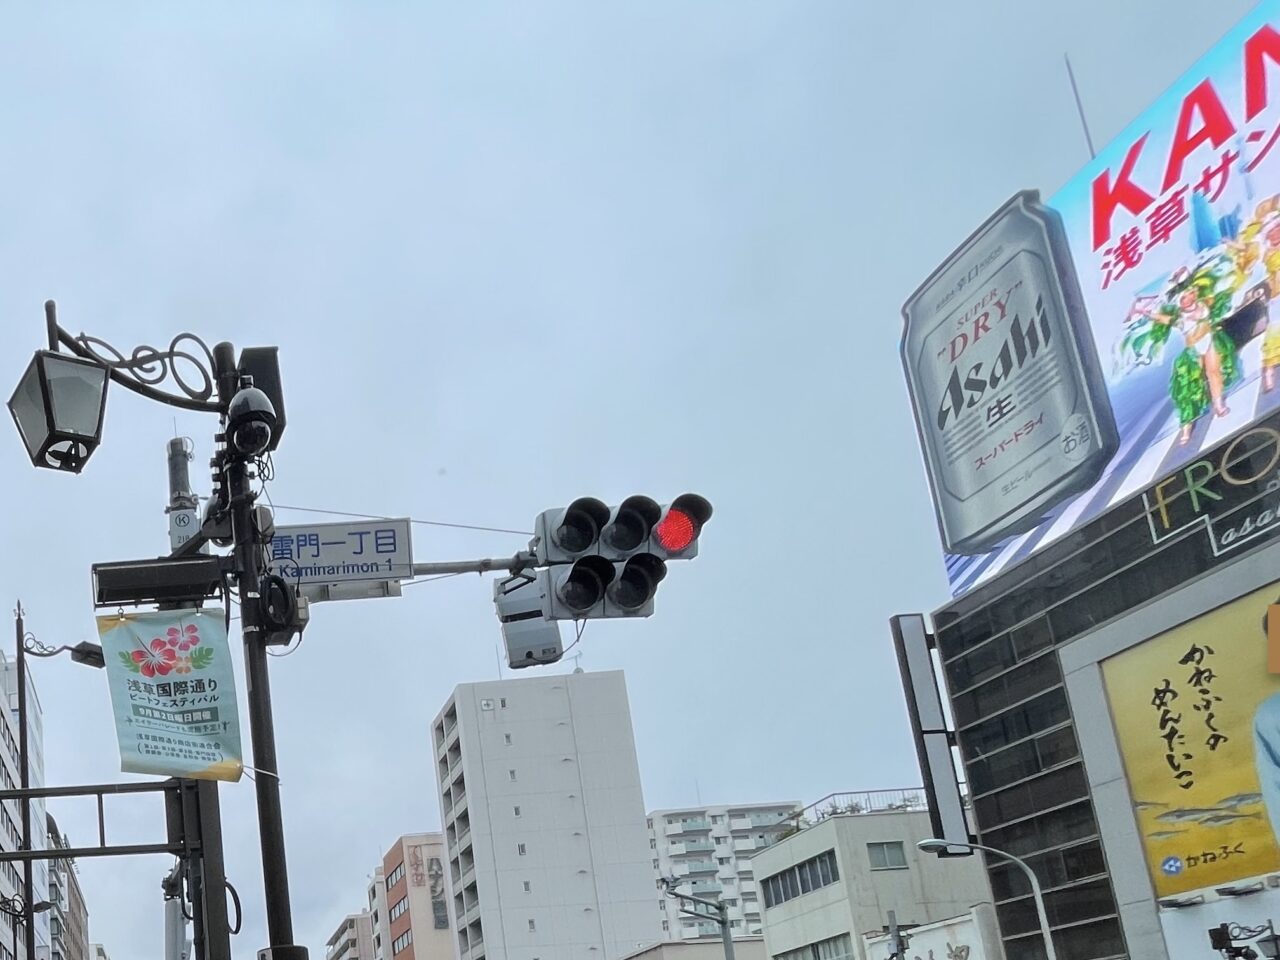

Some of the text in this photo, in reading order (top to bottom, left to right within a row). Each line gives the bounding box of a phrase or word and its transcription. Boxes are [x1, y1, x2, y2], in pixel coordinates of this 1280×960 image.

[957, 288, 998, 330] SUPER
[937, 294, 1051, 431] Asahi
[986, 393, 1016, 428] 生
[974, 412, 1043, 471] スーパードライ
[271, 529, 397, 559] 雷門一丁目
[280, 558, 393, 578] Kaminarimon 1
[127, 678, 218, 697] 浅草国際通り
[130, 694, 219, 708] ビートフェスティバル
[1151, 679, 1194, 789] めんたいこ
[1186, 842, 1245, 868] かねふく
